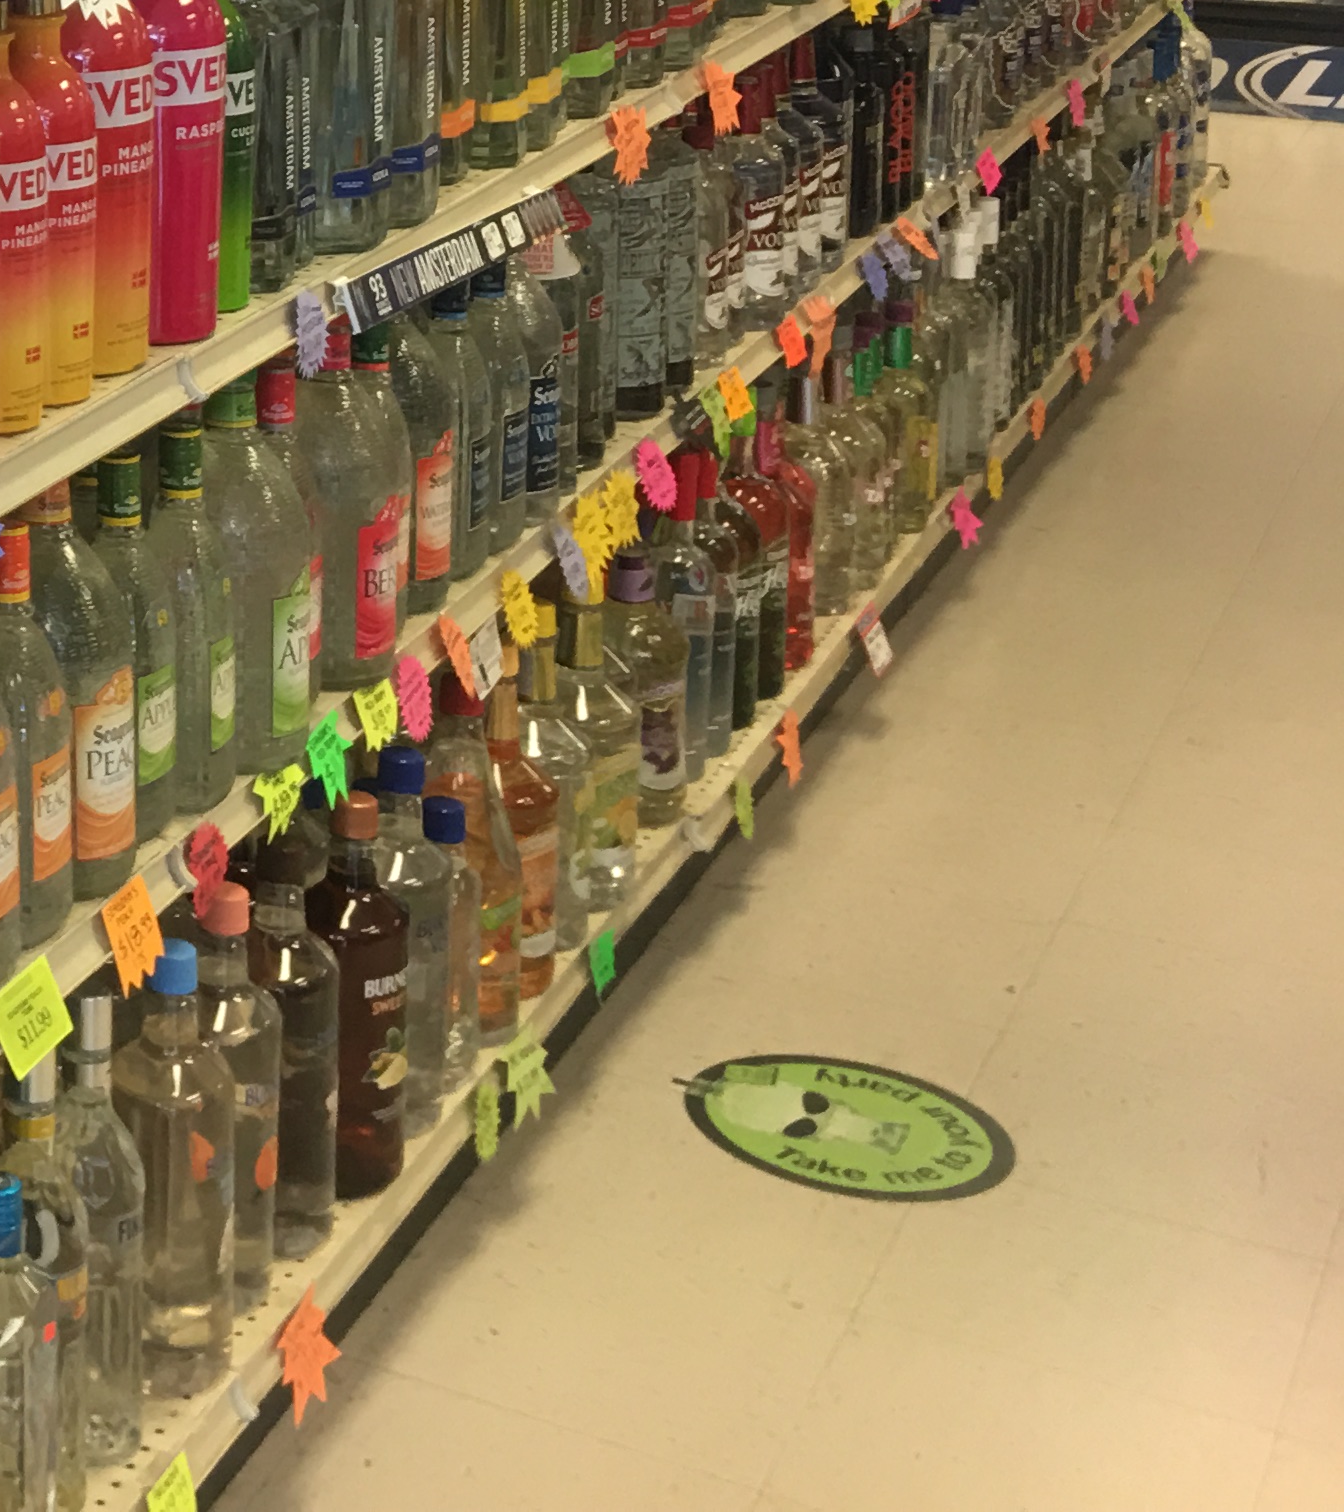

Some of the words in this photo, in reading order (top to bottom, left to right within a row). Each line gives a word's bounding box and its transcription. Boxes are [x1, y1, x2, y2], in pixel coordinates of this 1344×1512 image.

[373, 36, 385, 144] AMSTERDAM
[368, 272, 389, 303] 93
[413, 230, 486, 296] AMSTERDAM
[813, 1068, 920, 1103] party
[775, 1144, 868, 1183] Take
[882, 1163, 944, 1186] me
[934, 1149, 973, 1172] to
